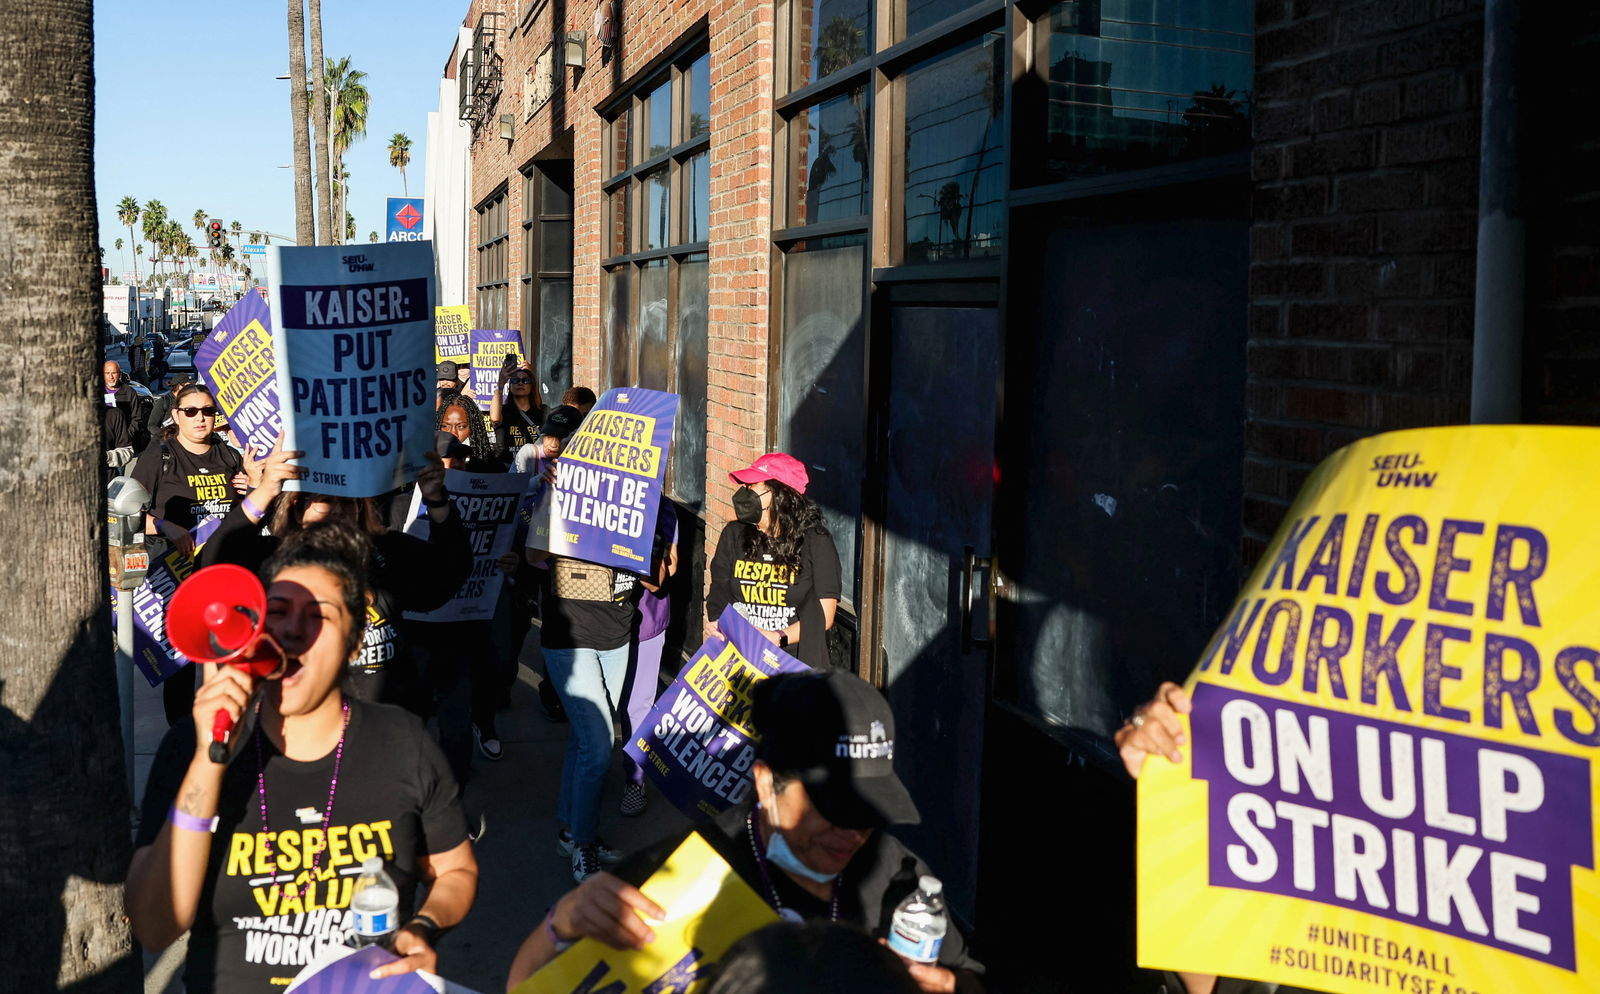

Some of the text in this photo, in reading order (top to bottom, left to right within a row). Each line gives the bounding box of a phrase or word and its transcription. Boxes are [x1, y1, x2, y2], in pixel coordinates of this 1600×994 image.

[305, 286, 410, 325] KAISER:
[435, 313, 462, 325] KAISER
[214, 328, 263, 384] KAISER
[333, 329, 392, 373] PUT
[437, 334, 466, 346] ON ULP
[439, 344, 468, 356] STRIKE
[482, 343, 516, 355] KAISER
[220, 340, 275, 410] WORKER
[475, 369, 500, 381] WON
[476, 354, 522, 368] WORKS
[233, 378, 280, 437] WON'T
[290, 368, 427, 417] PATIENTS
[320, 415, 408, 460] FIRST
[583, 411, 646, 444] KAISER
[565, 434, 654, 473] WORKERS
[1369, 453, 1424, 471] SEIU-
[187, 474, 227, 487] PATIENT
[196, 486, 227, 501] NEED
[313, 472, 347, 487] STRIKE
[556, 461, 650, 510] WON'T BE
[1376, 471, 1439, 489] UHW
[449, 496, 516, 521] SPECT
[553, 489, 645, 539] SILENCED
[1262, 513, 1549, 628] KAISER
[740, 584, 787, 606] VALUE
[355, 642, 395, 666] REED
[363, 624, 397, 647] ORATE
[720, 652, 757, 692] KAI
[1201, 597, 1600, 748] WORKERS
[694, 662, 763, 738] WORKE
[671, 687, 742, 758] WON'T
[636, 737, 671, 777] ULP STRIKE
[654, 712, 753, 806] SILENCED
[1220, 699, 1546, 843] ON ULP
[226, 819, 394, 877] RESPECT
[295, 859, 337, 886] and
[1226, 791, 1552, 955] STRIKE
[1307, 923, 1457, 977] #UNITED4ALL
